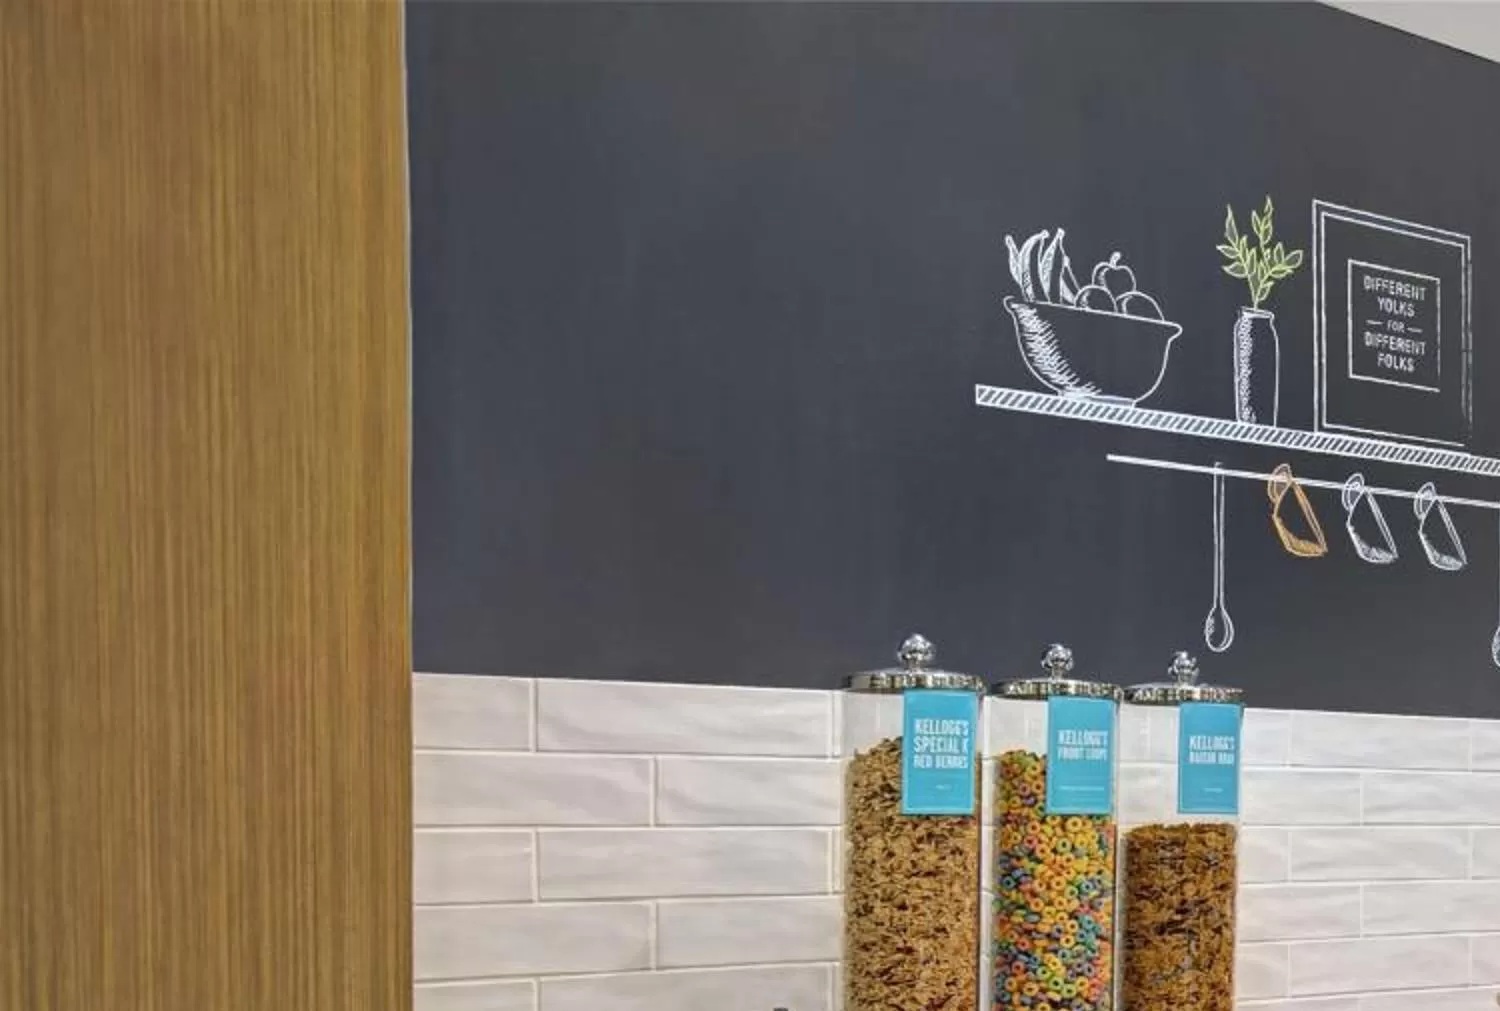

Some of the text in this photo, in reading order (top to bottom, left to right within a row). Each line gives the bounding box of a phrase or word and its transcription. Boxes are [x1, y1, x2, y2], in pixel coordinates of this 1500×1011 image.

[1363, 275, 1427, 301] DIFFERENT
[1377, 297, 1415, 317] YOLKS
[1387, 319, 1405, 333] FOR
[1363, 331, 1427, 355] DIFFERENT
[1377, 352, 1415, 373] FOLKS
[913, 734, 960, 754] SPECIAL
